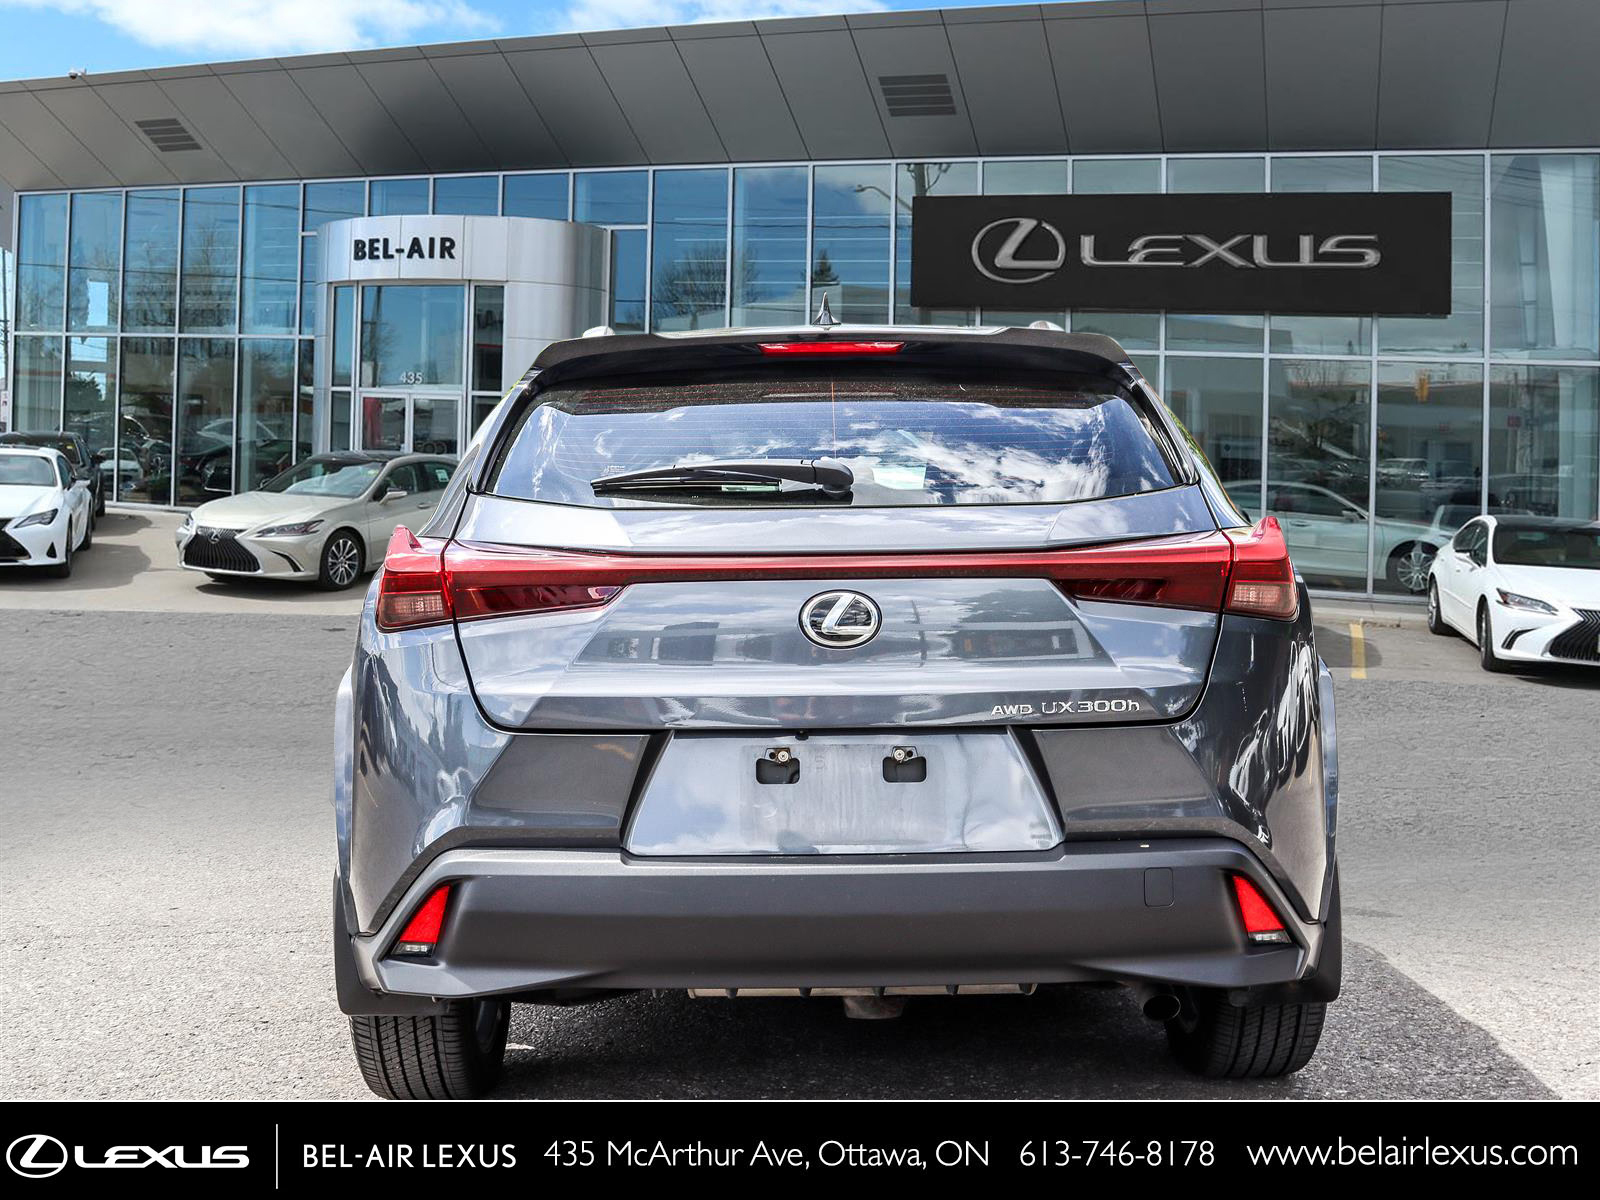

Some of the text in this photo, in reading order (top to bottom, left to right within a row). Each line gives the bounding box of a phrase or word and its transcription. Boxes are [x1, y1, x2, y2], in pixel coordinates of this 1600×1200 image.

[353, 237, 456, 261] BEL-AIR
[1080, 234, 1382, 268] LEXUS
[400, 371, 423, 384] 435
[991, 704, 1033, 715] AWD
